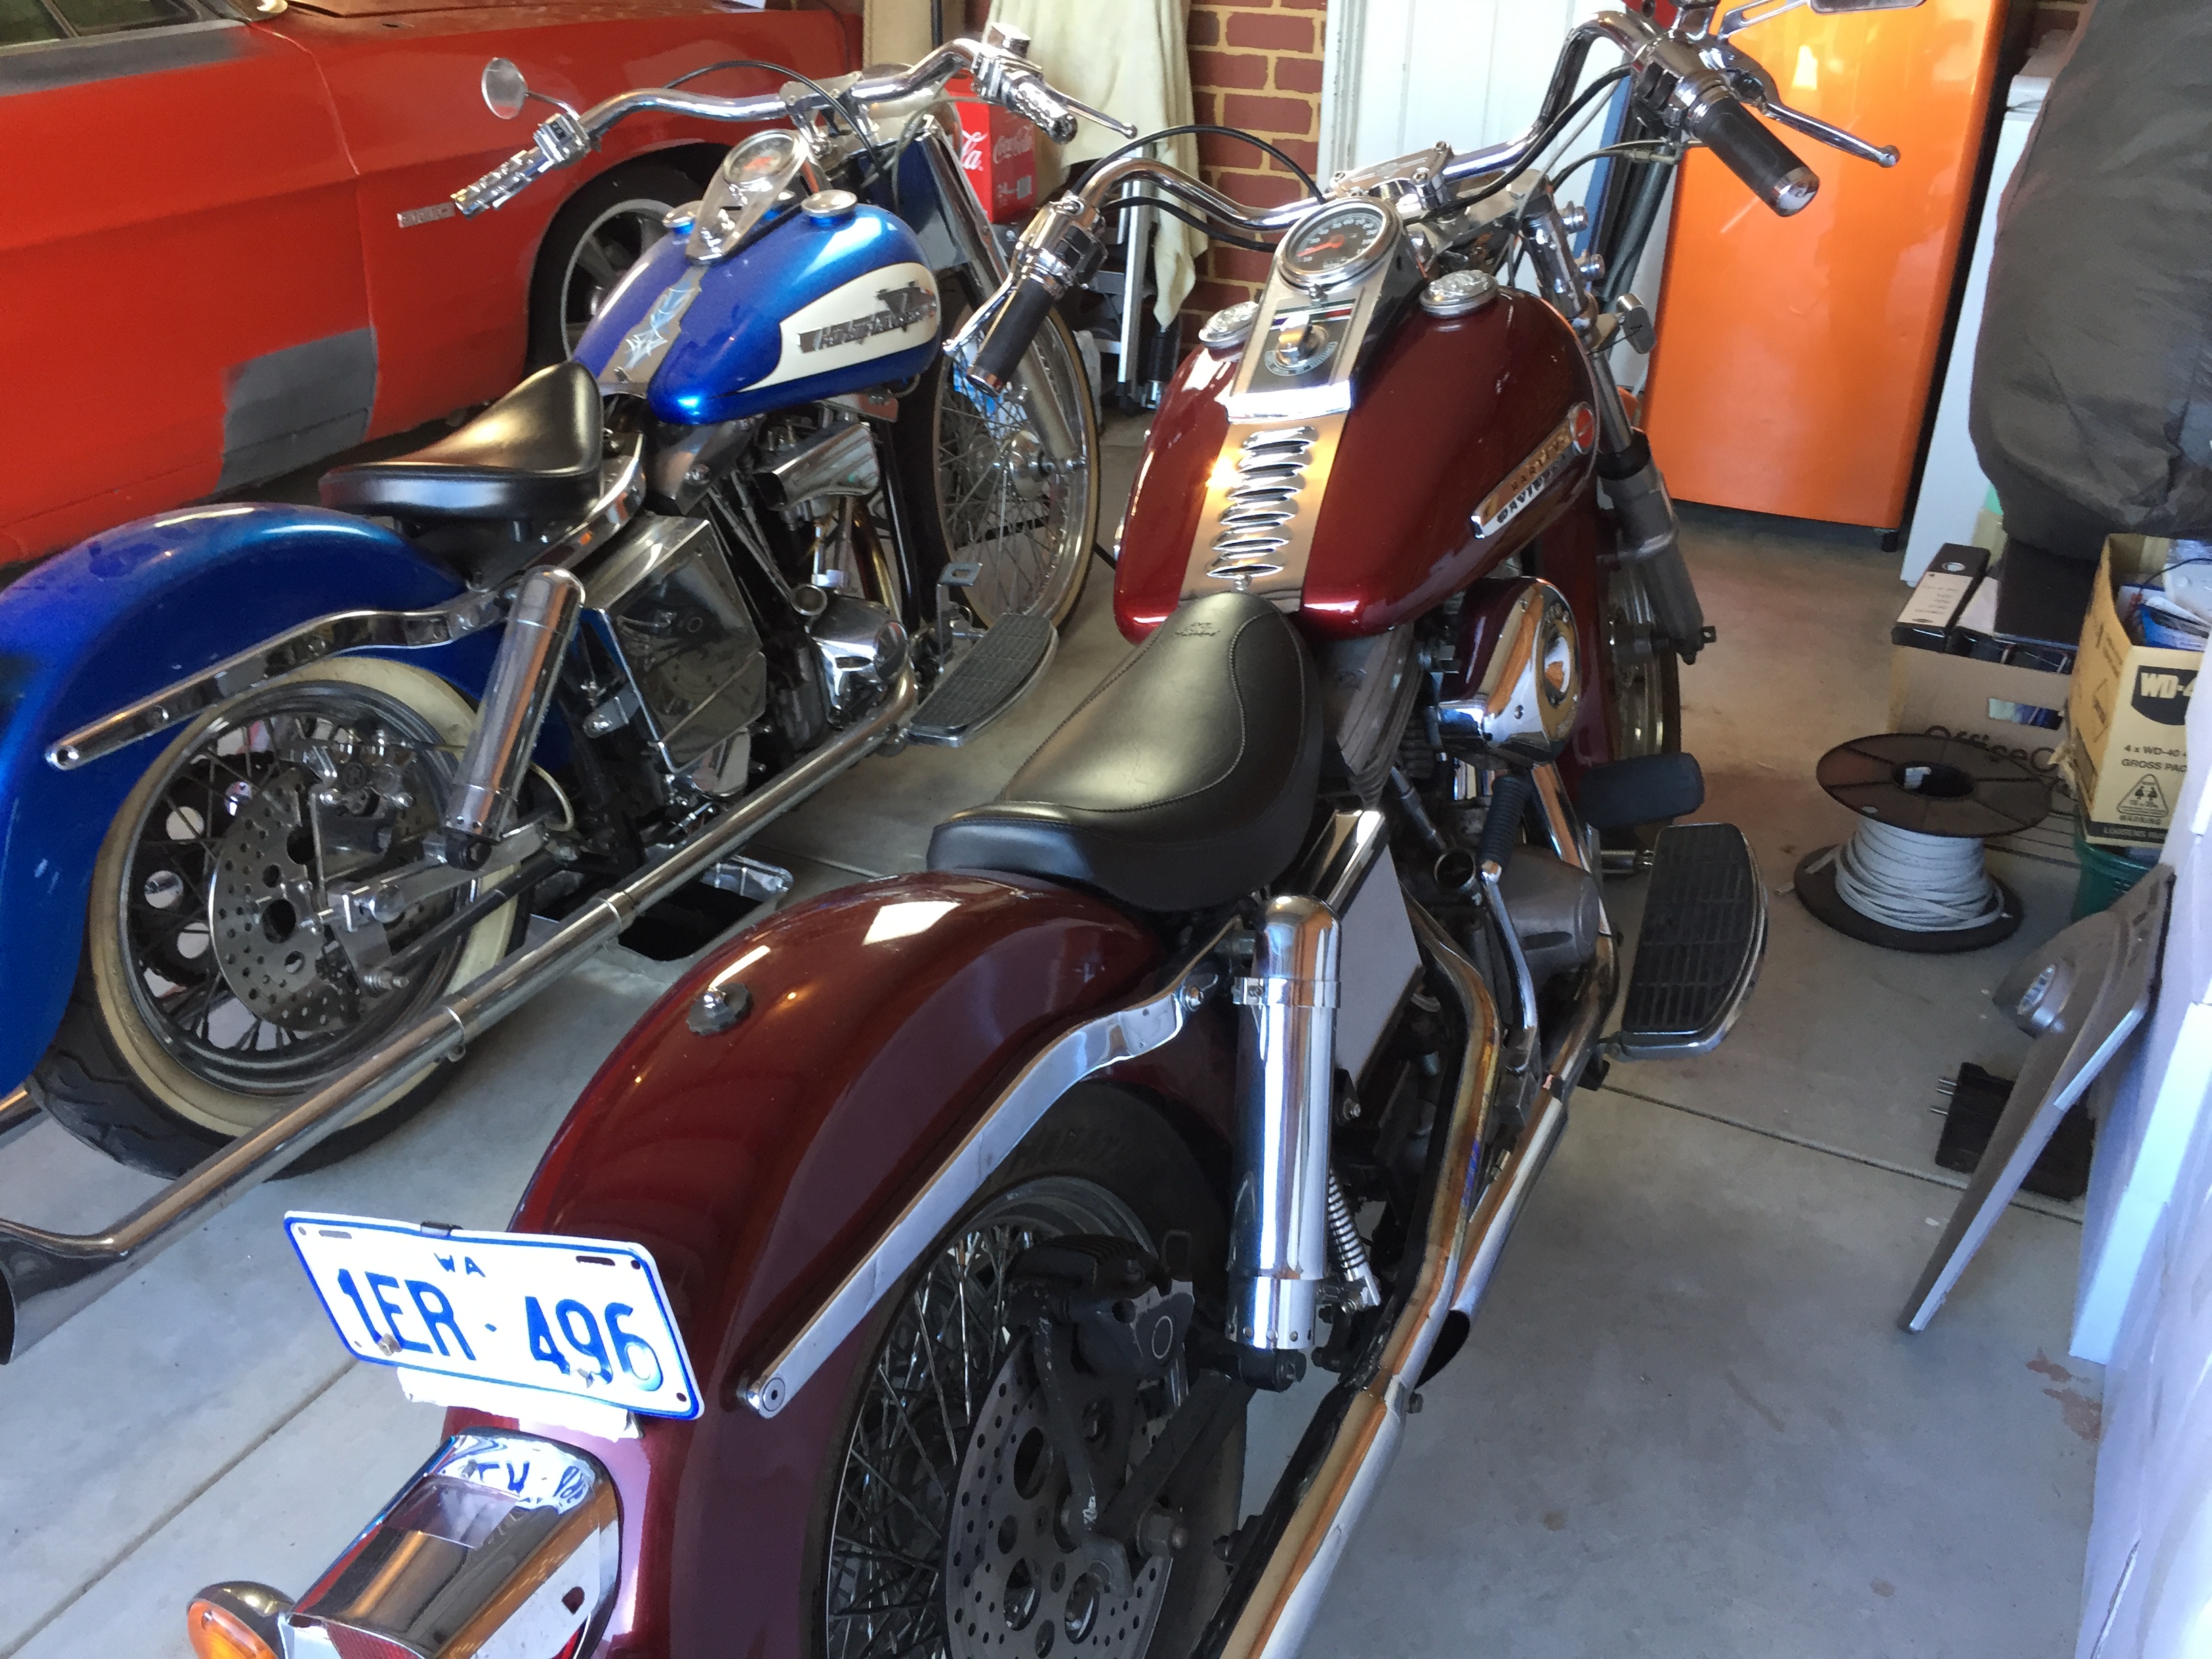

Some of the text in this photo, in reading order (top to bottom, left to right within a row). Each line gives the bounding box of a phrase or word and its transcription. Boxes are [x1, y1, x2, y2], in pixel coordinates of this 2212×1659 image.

[2140, 671, 2197, 699] WD-4
[2121, 758, 2188, 773] GROSS PAC
[433, 1252, 486, 1277] WA
[337, 1268, 663, 1391] 1ER 496
